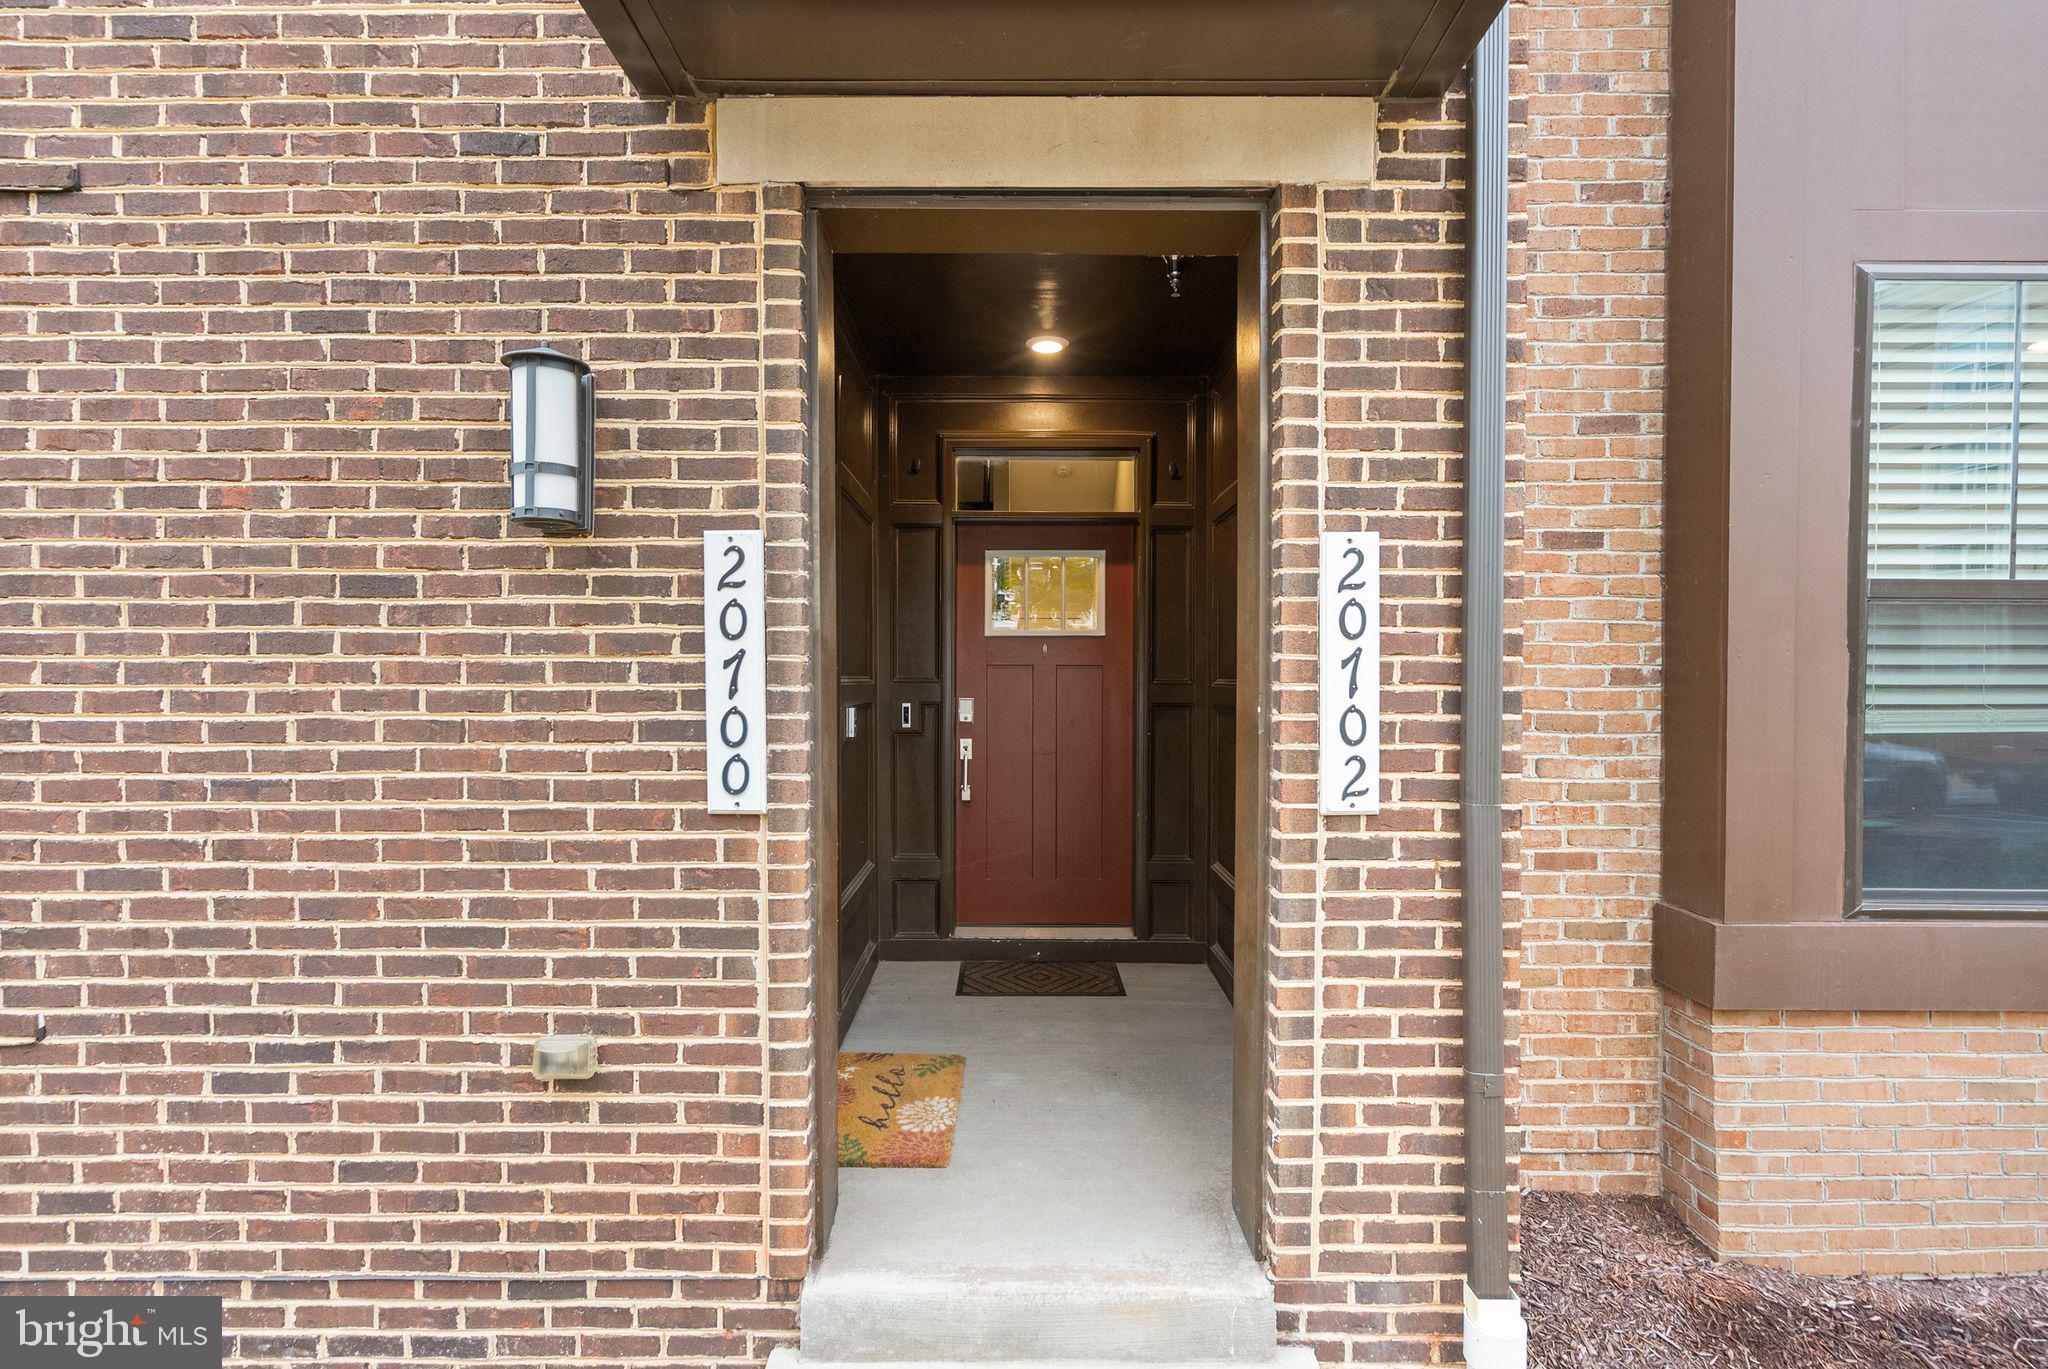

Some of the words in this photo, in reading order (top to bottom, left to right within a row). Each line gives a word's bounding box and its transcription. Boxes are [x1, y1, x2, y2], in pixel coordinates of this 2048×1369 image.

[717, 545, 750, 795] 20100
[1337, 547, 1369, 801] 20102
[858, 1067, 906, 1131] hello
